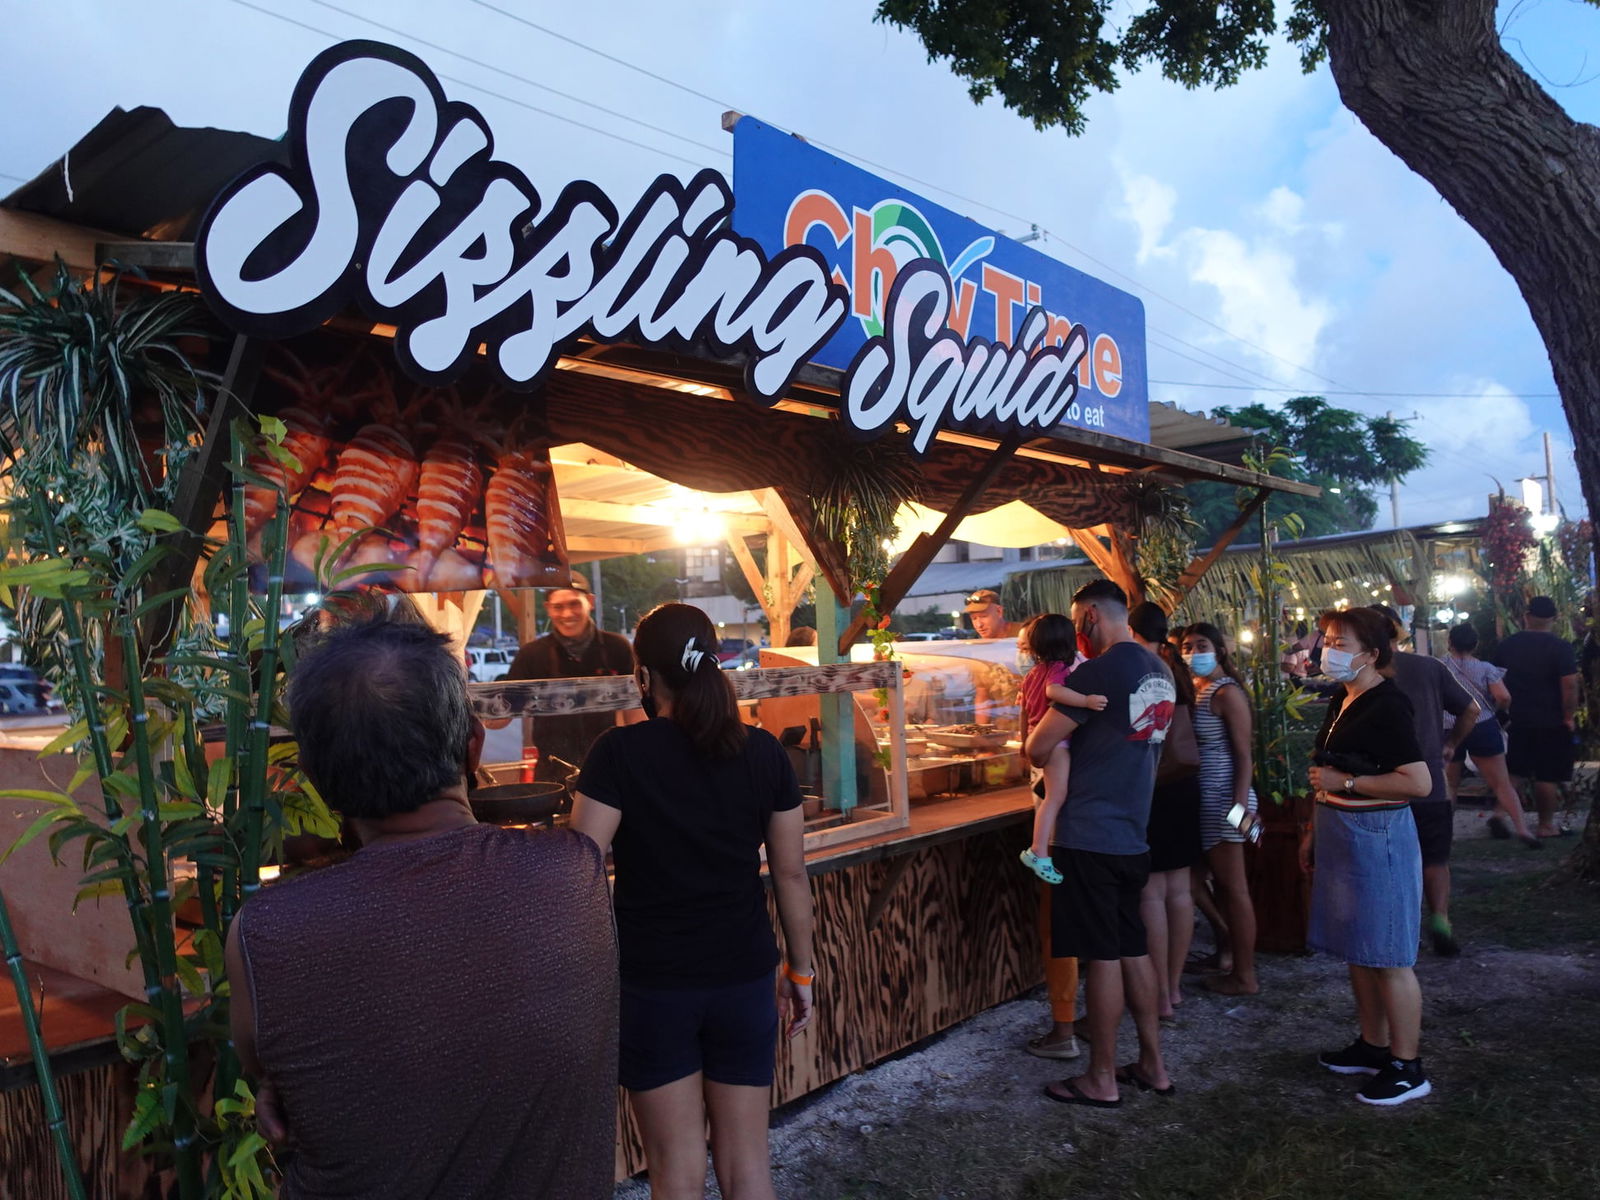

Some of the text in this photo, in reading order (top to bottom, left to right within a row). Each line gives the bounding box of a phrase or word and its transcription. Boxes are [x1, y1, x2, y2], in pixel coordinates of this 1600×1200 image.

[204, 55, 1085, 455] Sizzling Squid
[1084, 405, 1105, 427] eat
